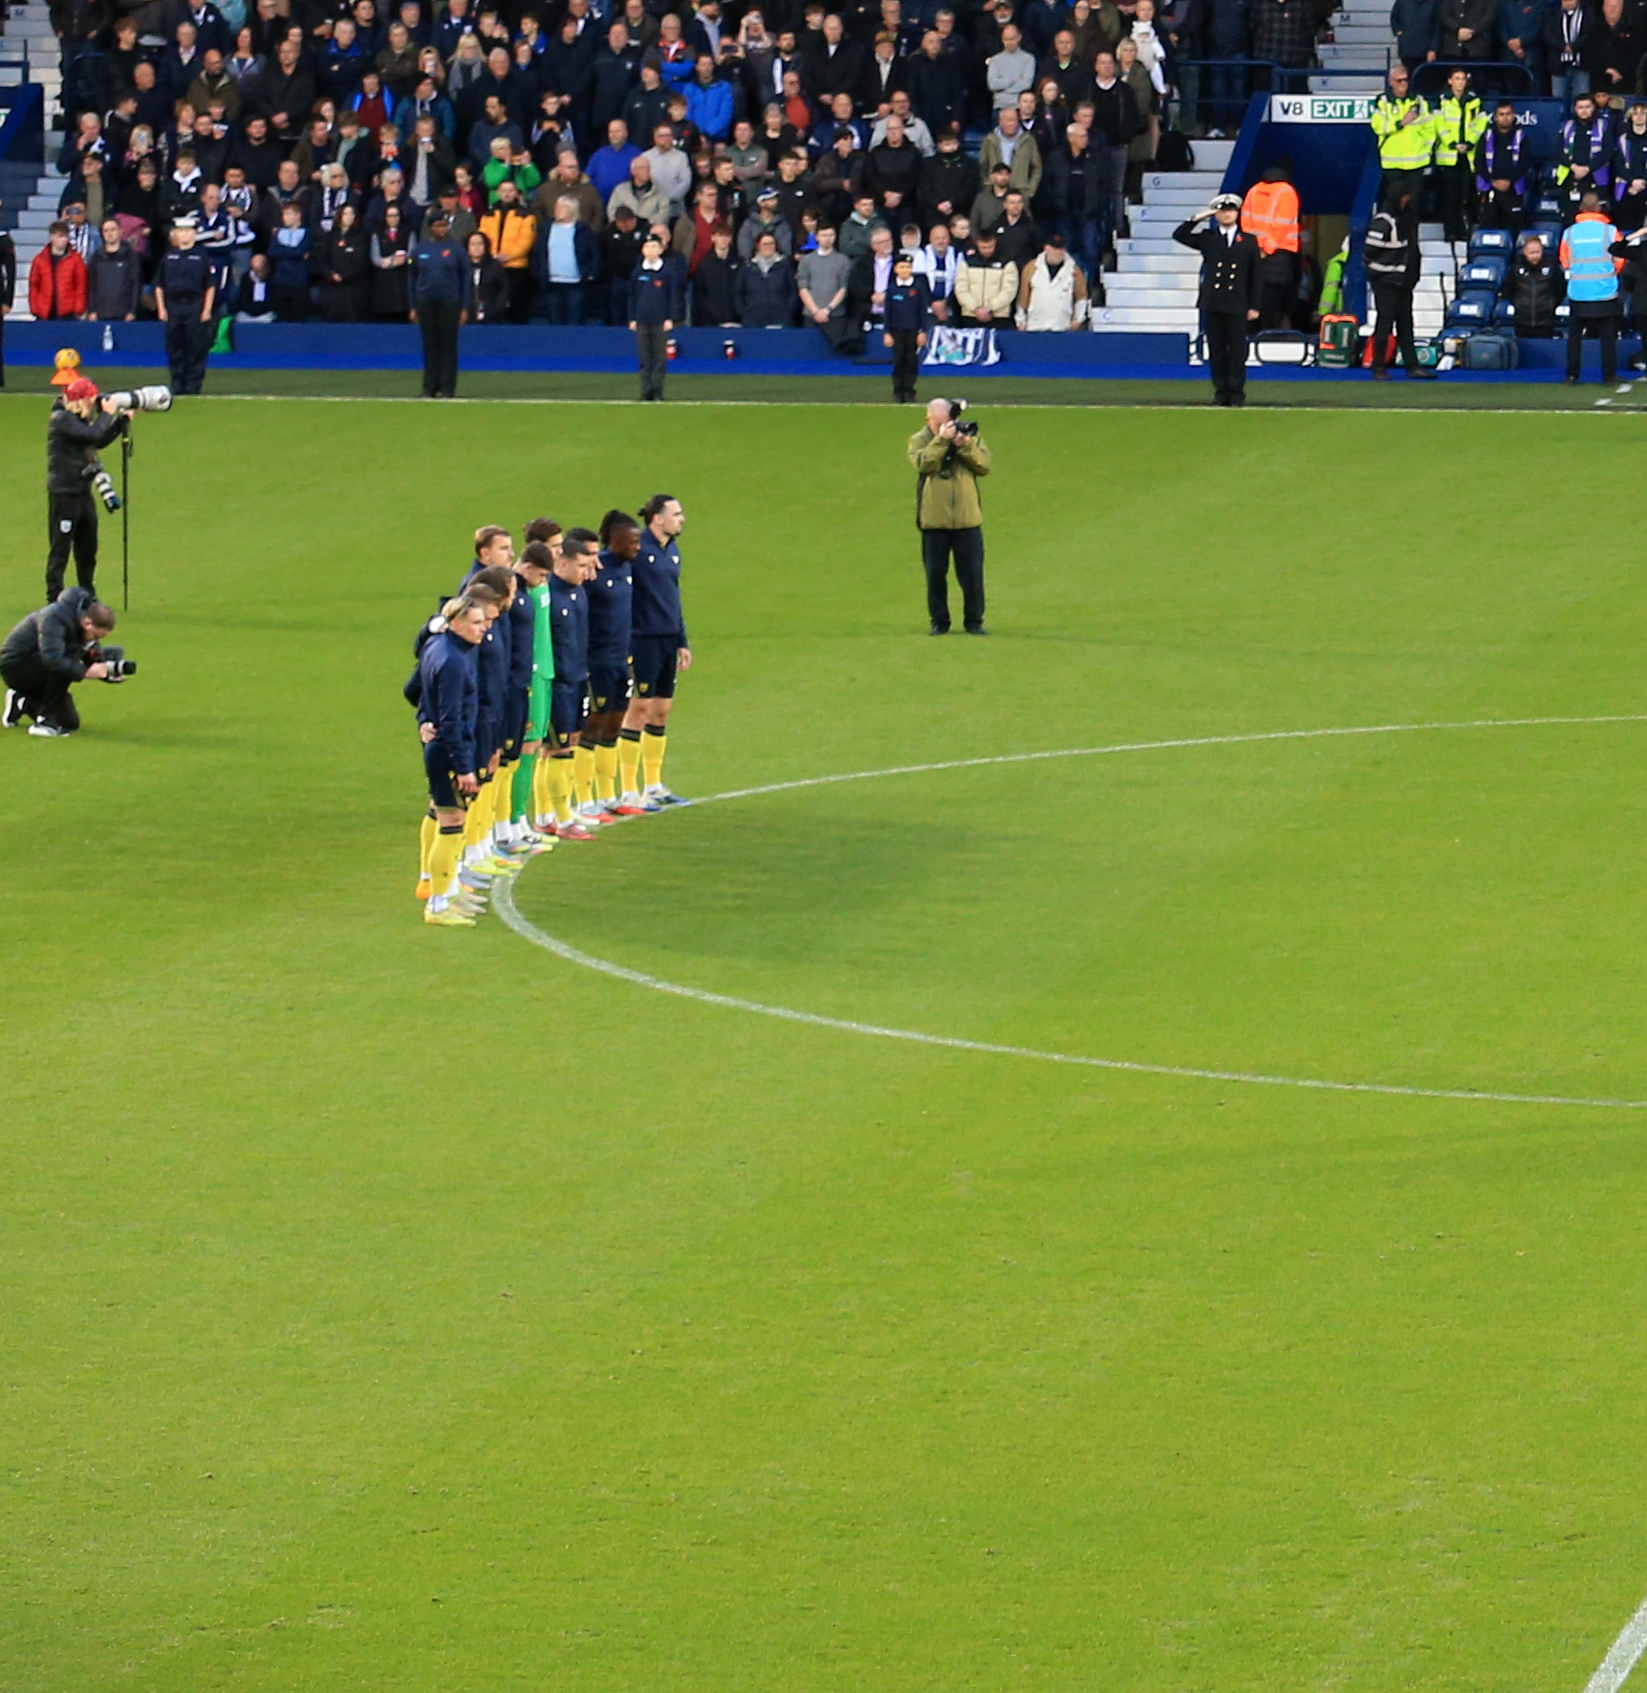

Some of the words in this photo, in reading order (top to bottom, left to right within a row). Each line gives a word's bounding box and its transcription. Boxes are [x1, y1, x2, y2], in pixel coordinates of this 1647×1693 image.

[1280, 102, 1303, 115] V8
[1314, 100, 1351, 118] EXIT
[1152, 176, 1160, 186] G
